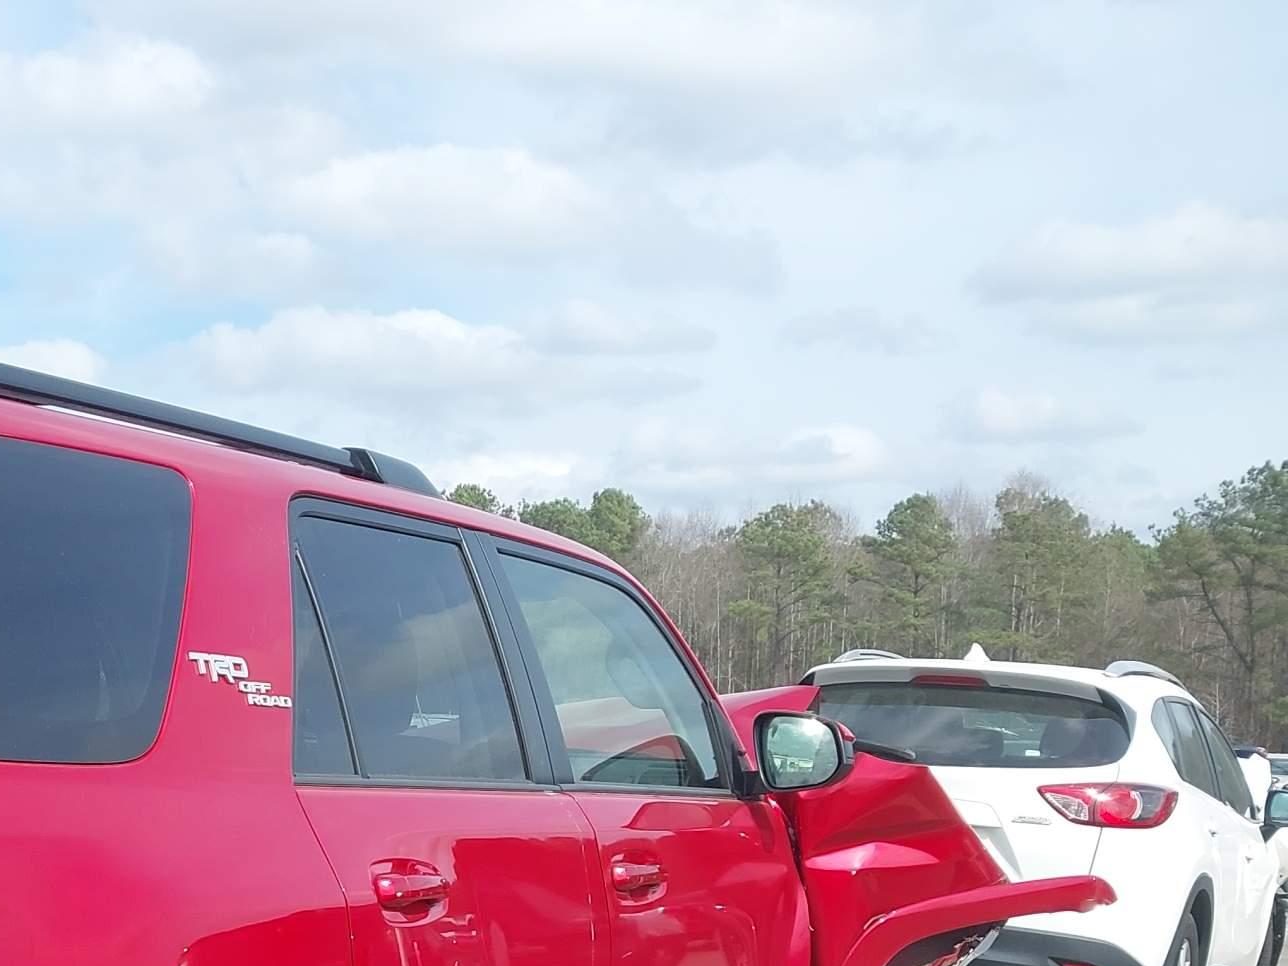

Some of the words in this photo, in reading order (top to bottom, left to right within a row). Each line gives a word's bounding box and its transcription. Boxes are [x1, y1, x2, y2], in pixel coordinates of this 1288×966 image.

[188, 651, 249, 683] TRD
[238, 681, 272, 694] OFF
[247, 693, 293, 708] ROAD
